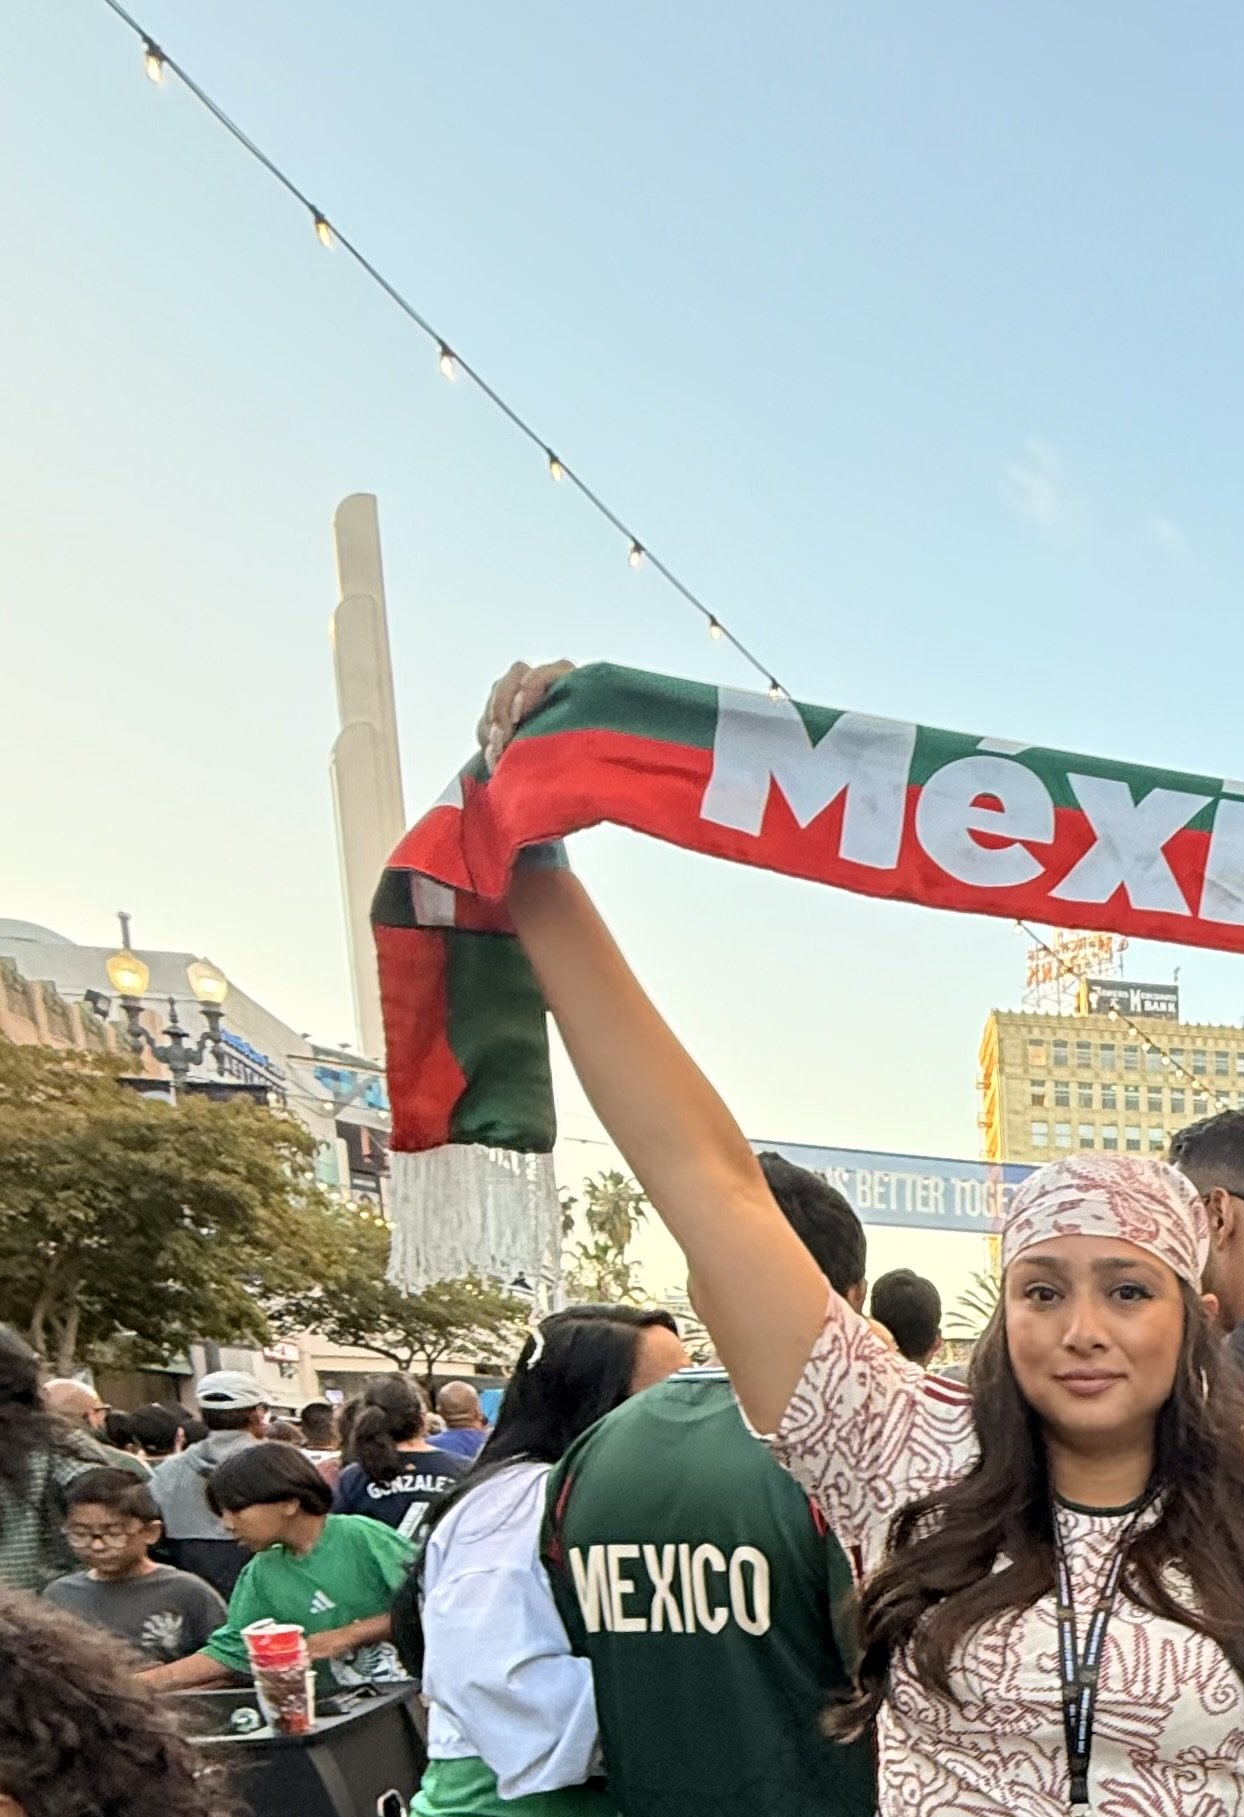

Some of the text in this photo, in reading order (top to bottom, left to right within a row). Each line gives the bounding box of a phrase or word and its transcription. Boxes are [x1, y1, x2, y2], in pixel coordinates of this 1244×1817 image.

[1144, 1001, 1177, 1013] BANK
[856, 1168, 946, 1215] BETTER
[951, 1176, 1015, 1220] TOGE
[366, 1474, 456, 1500] GNZALE
[568, 1542, 772, 1637] MEXICO
